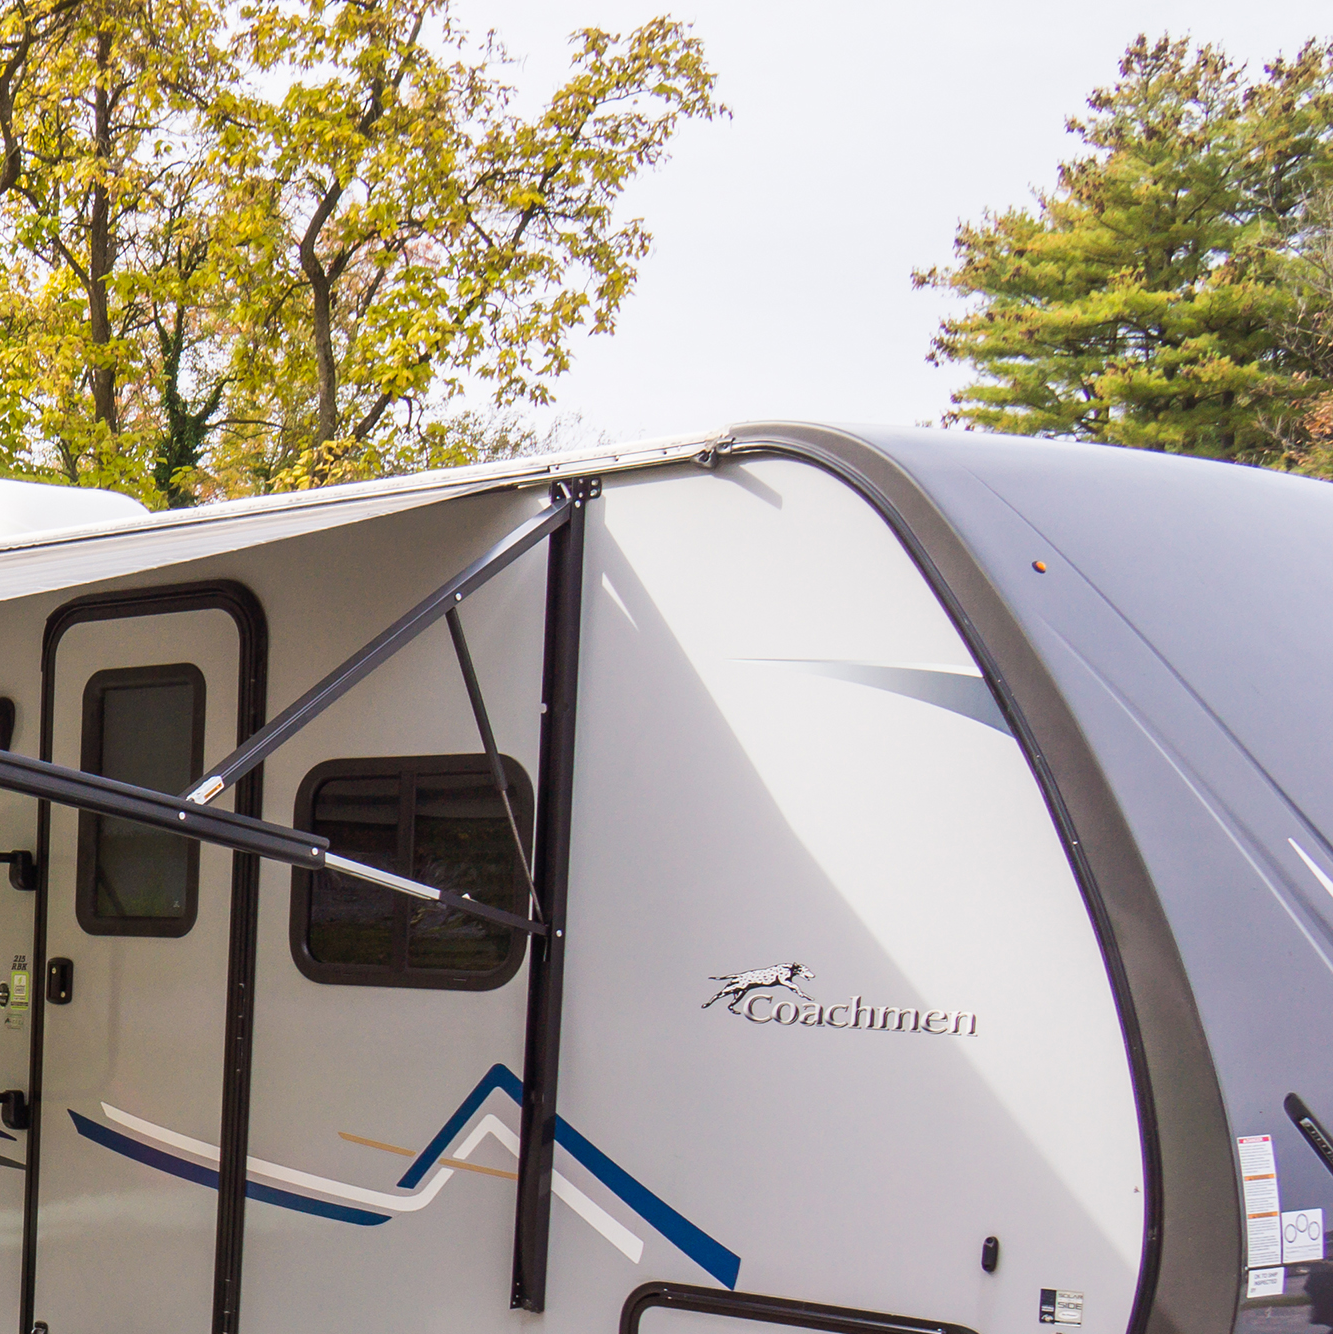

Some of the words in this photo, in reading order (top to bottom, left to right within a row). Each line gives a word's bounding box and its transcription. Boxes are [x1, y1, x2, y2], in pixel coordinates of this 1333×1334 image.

[13, 954, 26, 963] 215
[11, 962, 28, 971] RBK
[742, 993, 978, 1037] Coachmen
[1058, 1301, 1083, 1310] SIDE
